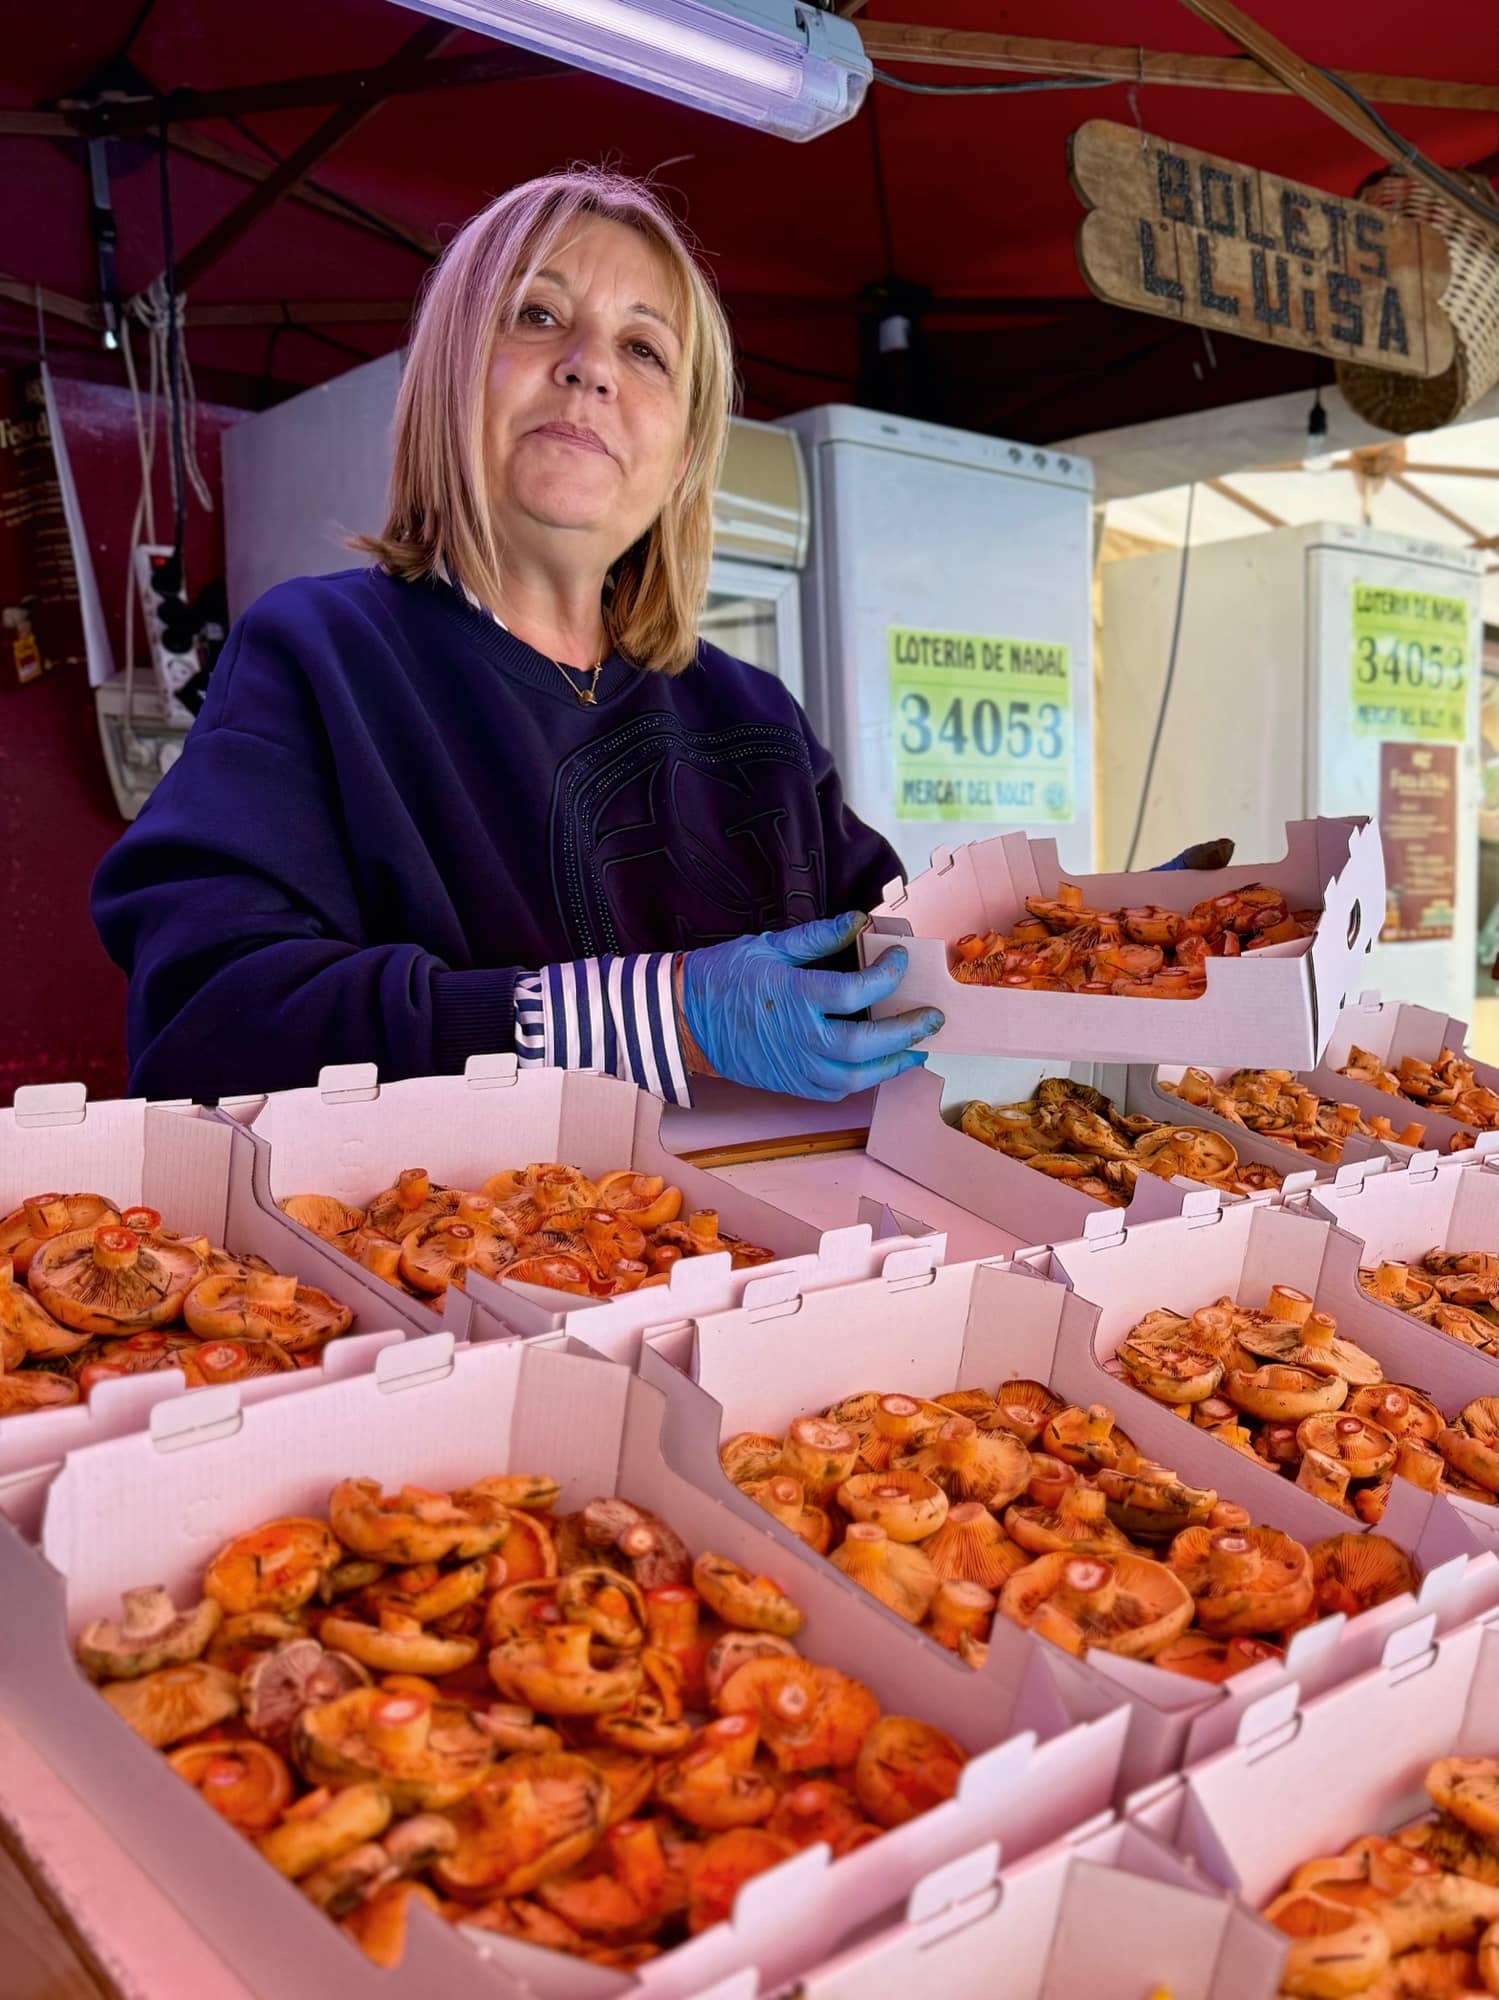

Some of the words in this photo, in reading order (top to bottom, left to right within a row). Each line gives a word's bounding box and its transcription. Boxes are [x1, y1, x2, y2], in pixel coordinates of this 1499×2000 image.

[1157, 149, 1388, 280] BOLETS
[895, 634, 975, 669] LOTERIA
[982, 643, 1004, 672] DE
[1010, 645, 1067, 678] NADAL
[1357, 636, 1464, 691] 34053
[900, 693, 1063, 760] 34053
[903, 779, 962, 805] MERCAT
